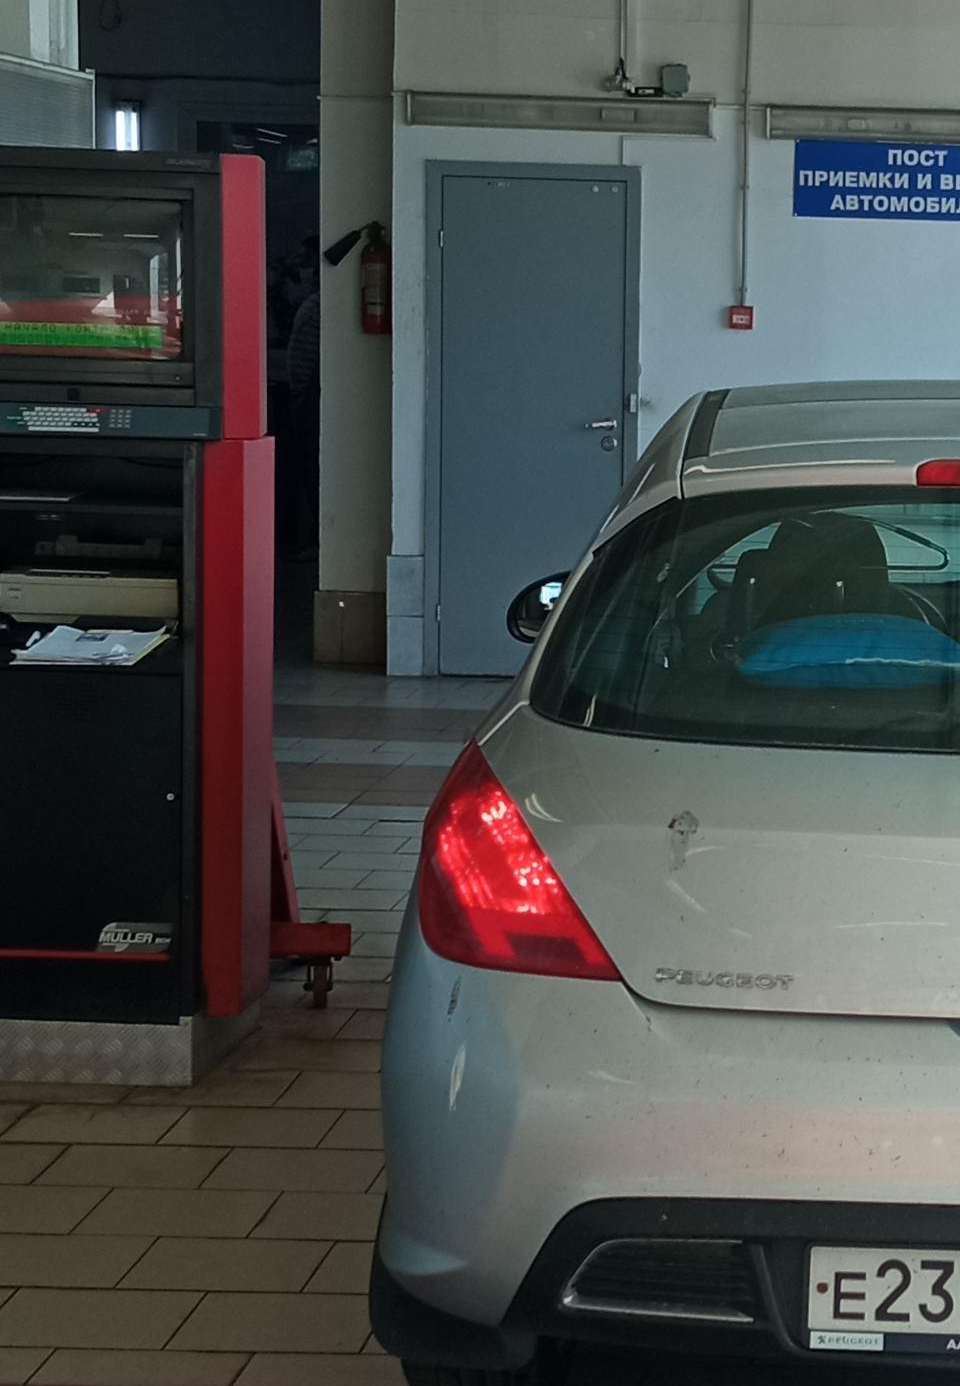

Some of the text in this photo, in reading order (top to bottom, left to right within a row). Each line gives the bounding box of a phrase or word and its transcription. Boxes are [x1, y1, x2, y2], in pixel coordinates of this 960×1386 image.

[887, 148, 949, 167] ПОСТ
[799, 170, 909, 189] ПРИЕМКИ
[916, 173, 932, 190] И
[655, 967, 795, 990] PEUGEOT
